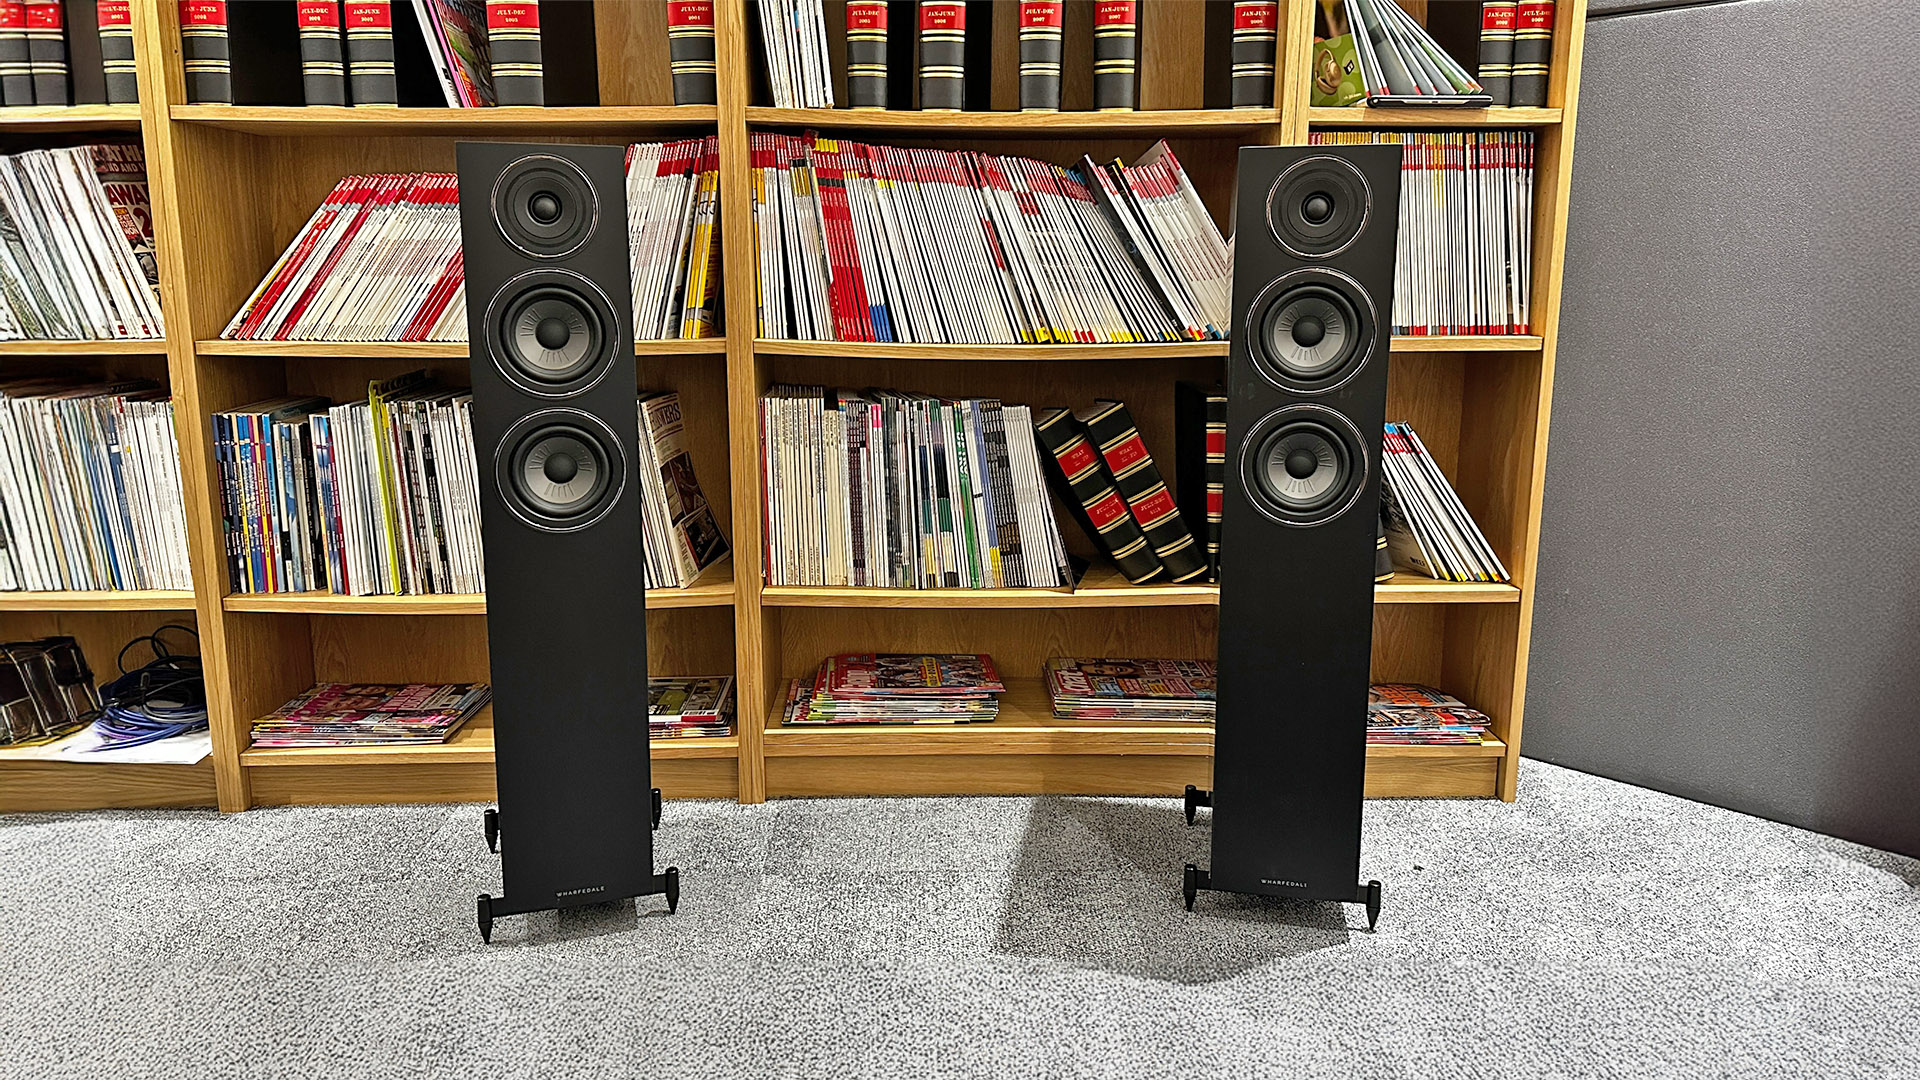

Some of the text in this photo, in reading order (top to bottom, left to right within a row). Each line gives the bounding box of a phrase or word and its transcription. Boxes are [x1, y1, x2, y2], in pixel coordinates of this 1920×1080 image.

[106, 184, 149, 205] AWA
[1260, 878, 1308, 888] WHARFEDALE
[556, 885, 605, 897] WHARFEDALE
